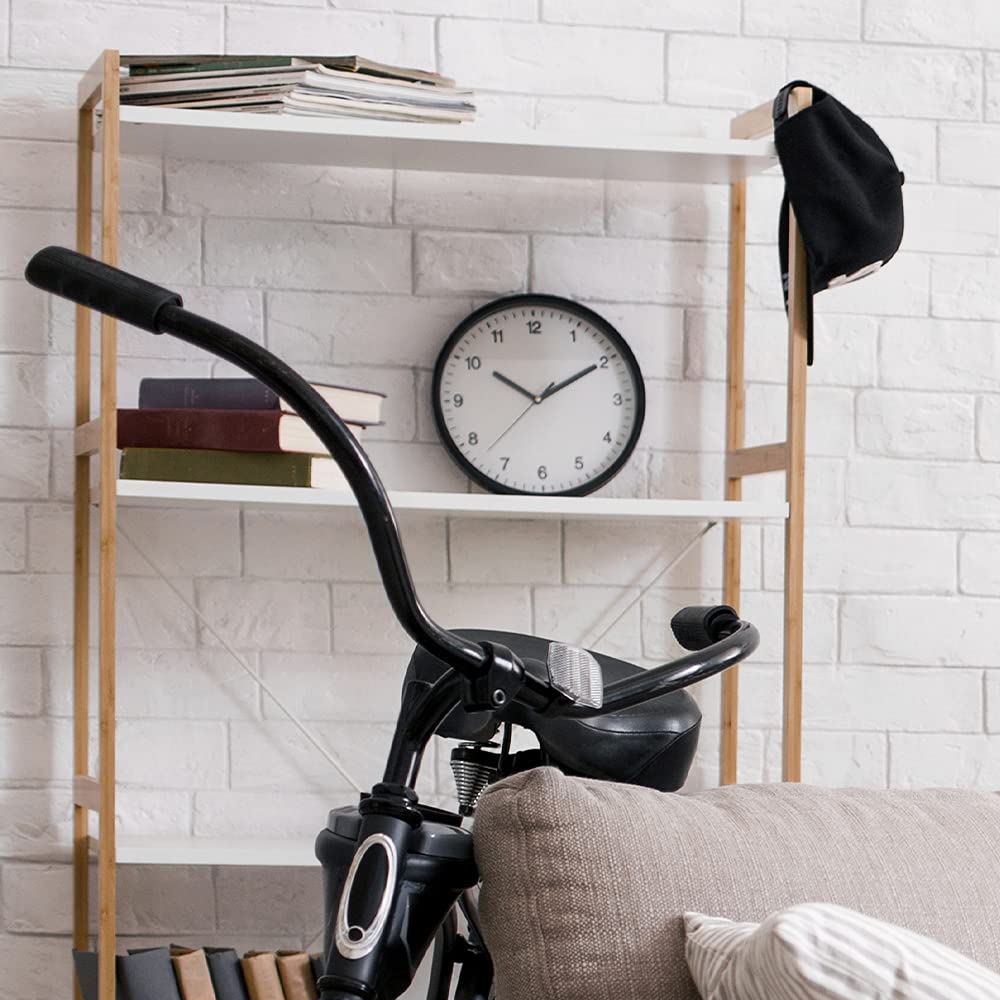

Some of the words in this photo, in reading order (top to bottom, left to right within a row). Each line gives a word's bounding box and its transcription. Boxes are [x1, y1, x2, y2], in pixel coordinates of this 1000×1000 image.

[526, 320, 542, 335] 12
[491, 330, 504, 343] 11
[570, 330, 577, 342] 1
[465, 355, 482, 370] 10
[599, 355, 609, 369] 2
[453, 394, 464, 408] 9
[612, 393, 623, 406] 3
[468, 432, 479, 446] 8
[602, 431, 613, 444] 4
[499, 457, 510, 470] 7
[574, 456, 585, 470] 5
[537, 466, 548, 480] 6
